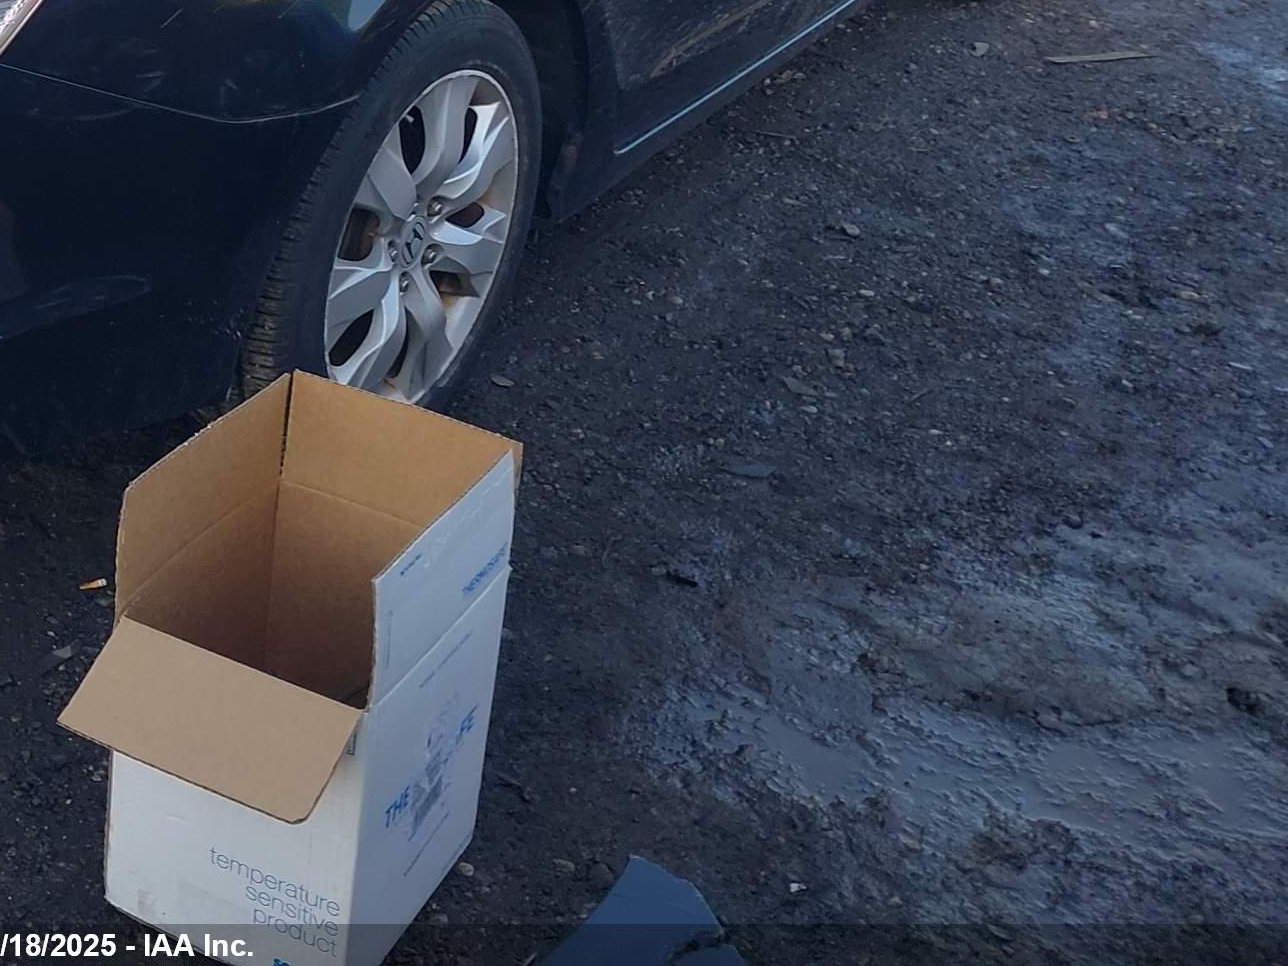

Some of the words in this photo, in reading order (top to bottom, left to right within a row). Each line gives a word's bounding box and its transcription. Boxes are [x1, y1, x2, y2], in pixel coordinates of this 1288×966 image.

[385, 785, 410, 829] THE
[209, 847, 341, 917] temperature
[245, 885, 339, 937] sensitive
[252, 908, 337, 958] product
